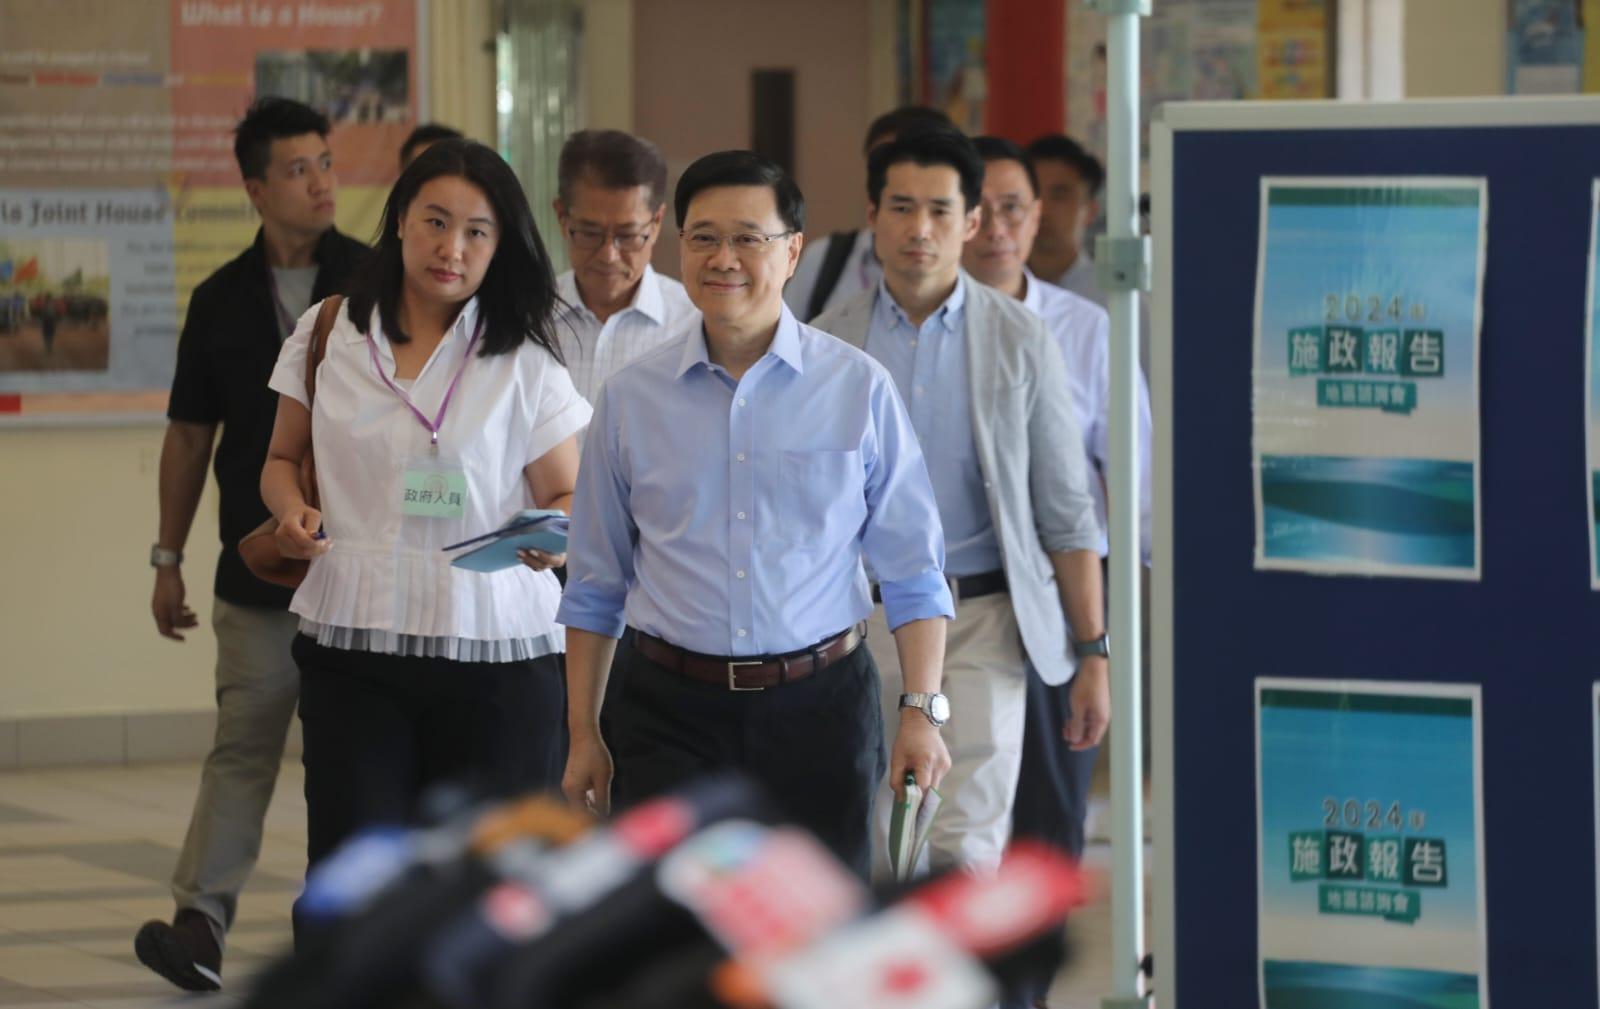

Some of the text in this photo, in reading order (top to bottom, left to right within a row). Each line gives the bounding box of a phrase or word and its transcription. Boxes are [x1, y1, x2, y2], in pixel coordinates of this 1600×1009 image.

[1291, 329, 1441, 373] 施政報告
[404, 488, 461, 506] 政府人員
[1291, 834, 1442, 882] 施政報告
